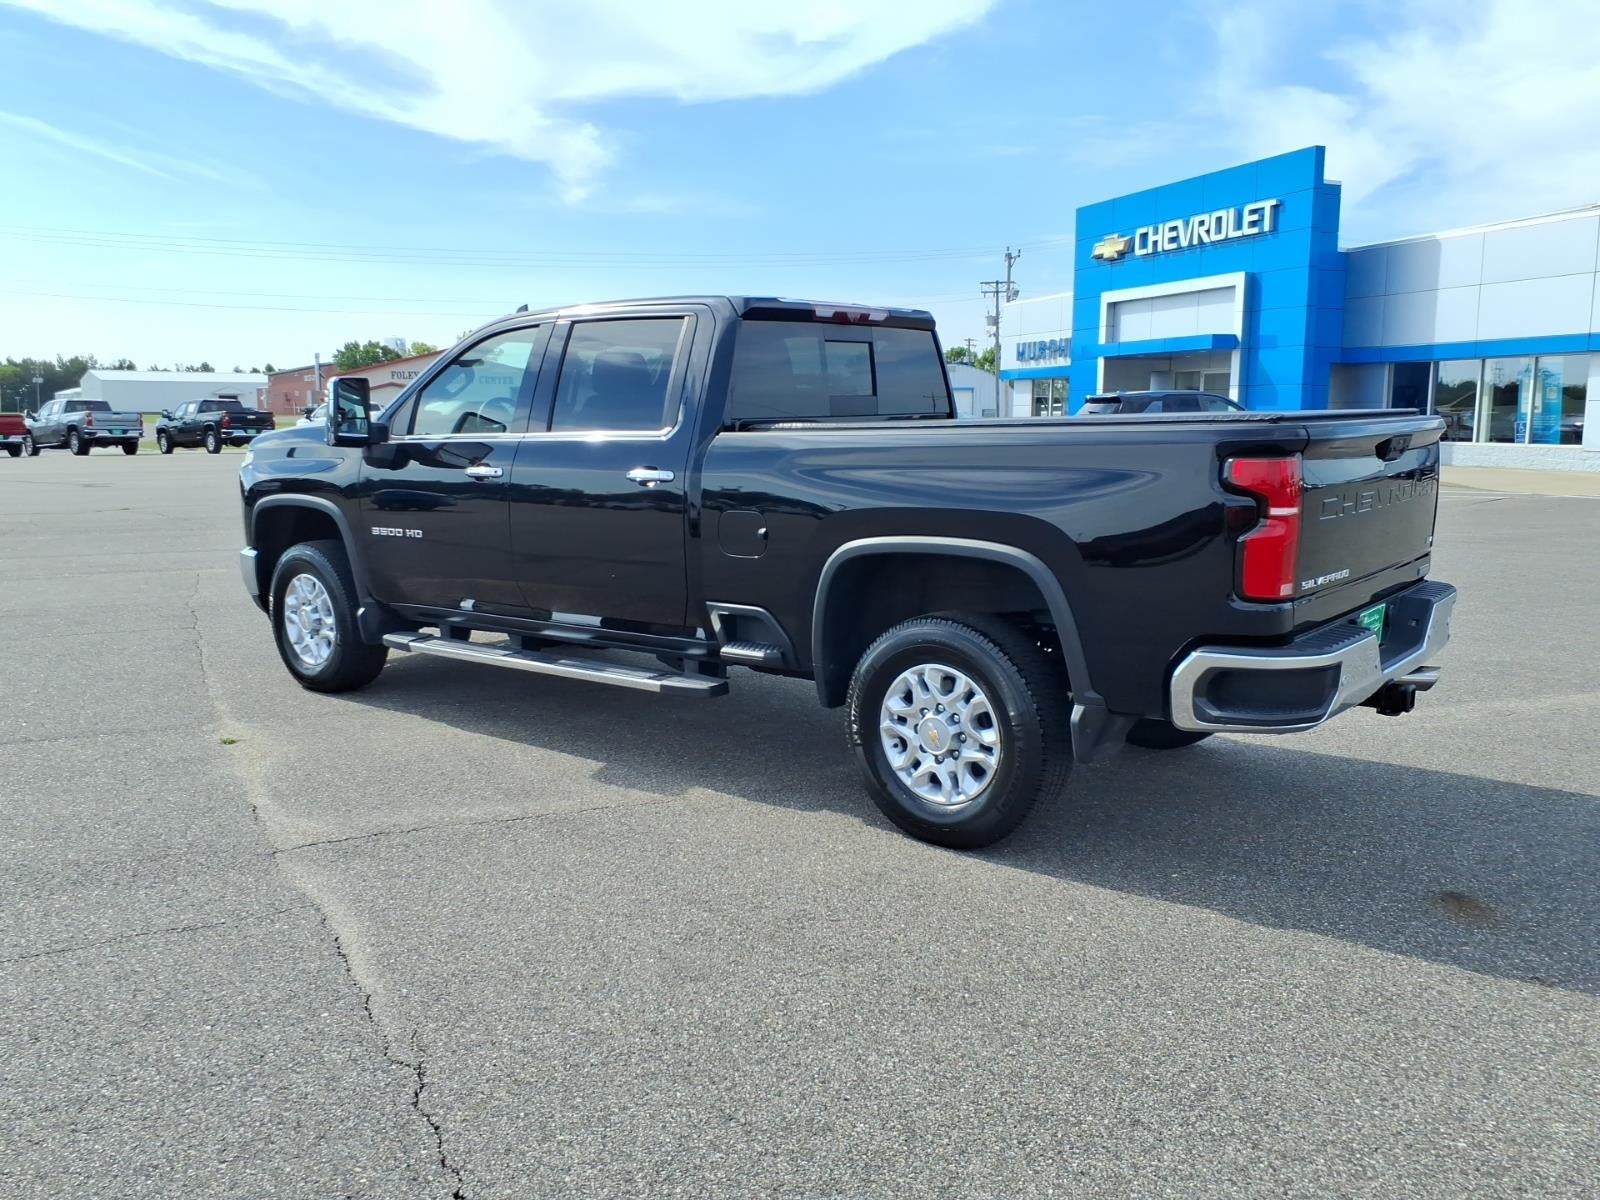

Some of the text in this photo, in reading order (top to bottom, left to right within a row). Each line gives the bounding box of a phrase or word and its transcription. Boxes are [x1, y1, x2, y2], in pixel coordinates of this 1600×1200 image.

[1134, 198, 1280, 256] CHEVROLET
[479, 375, 515, 385] CENTER
[370, 526, 423, 538] 3500 HD
[1301, 568, 1350, 591] SILVERADO
